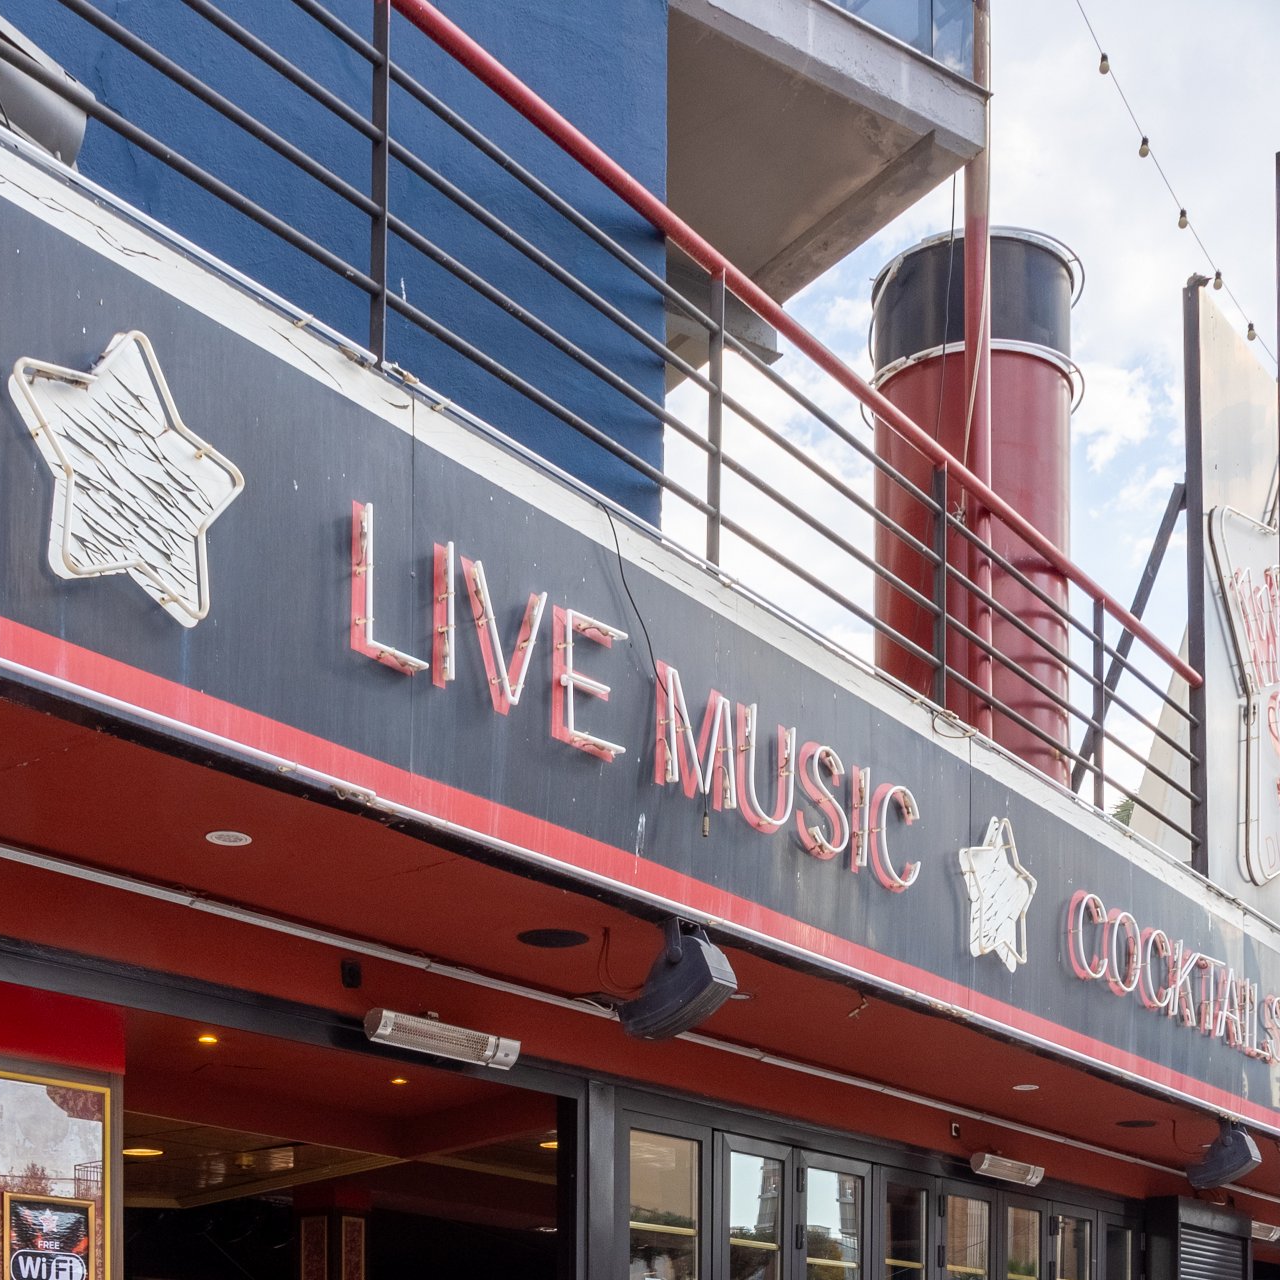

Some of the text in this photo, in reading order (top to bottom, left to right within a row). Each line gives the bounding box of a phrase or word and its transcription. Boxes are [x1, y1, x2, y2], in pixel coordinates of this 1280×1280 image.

[350, 499, 921, 894] LIVE MUSIC
[37, 1240, 61, 1250] FREE
